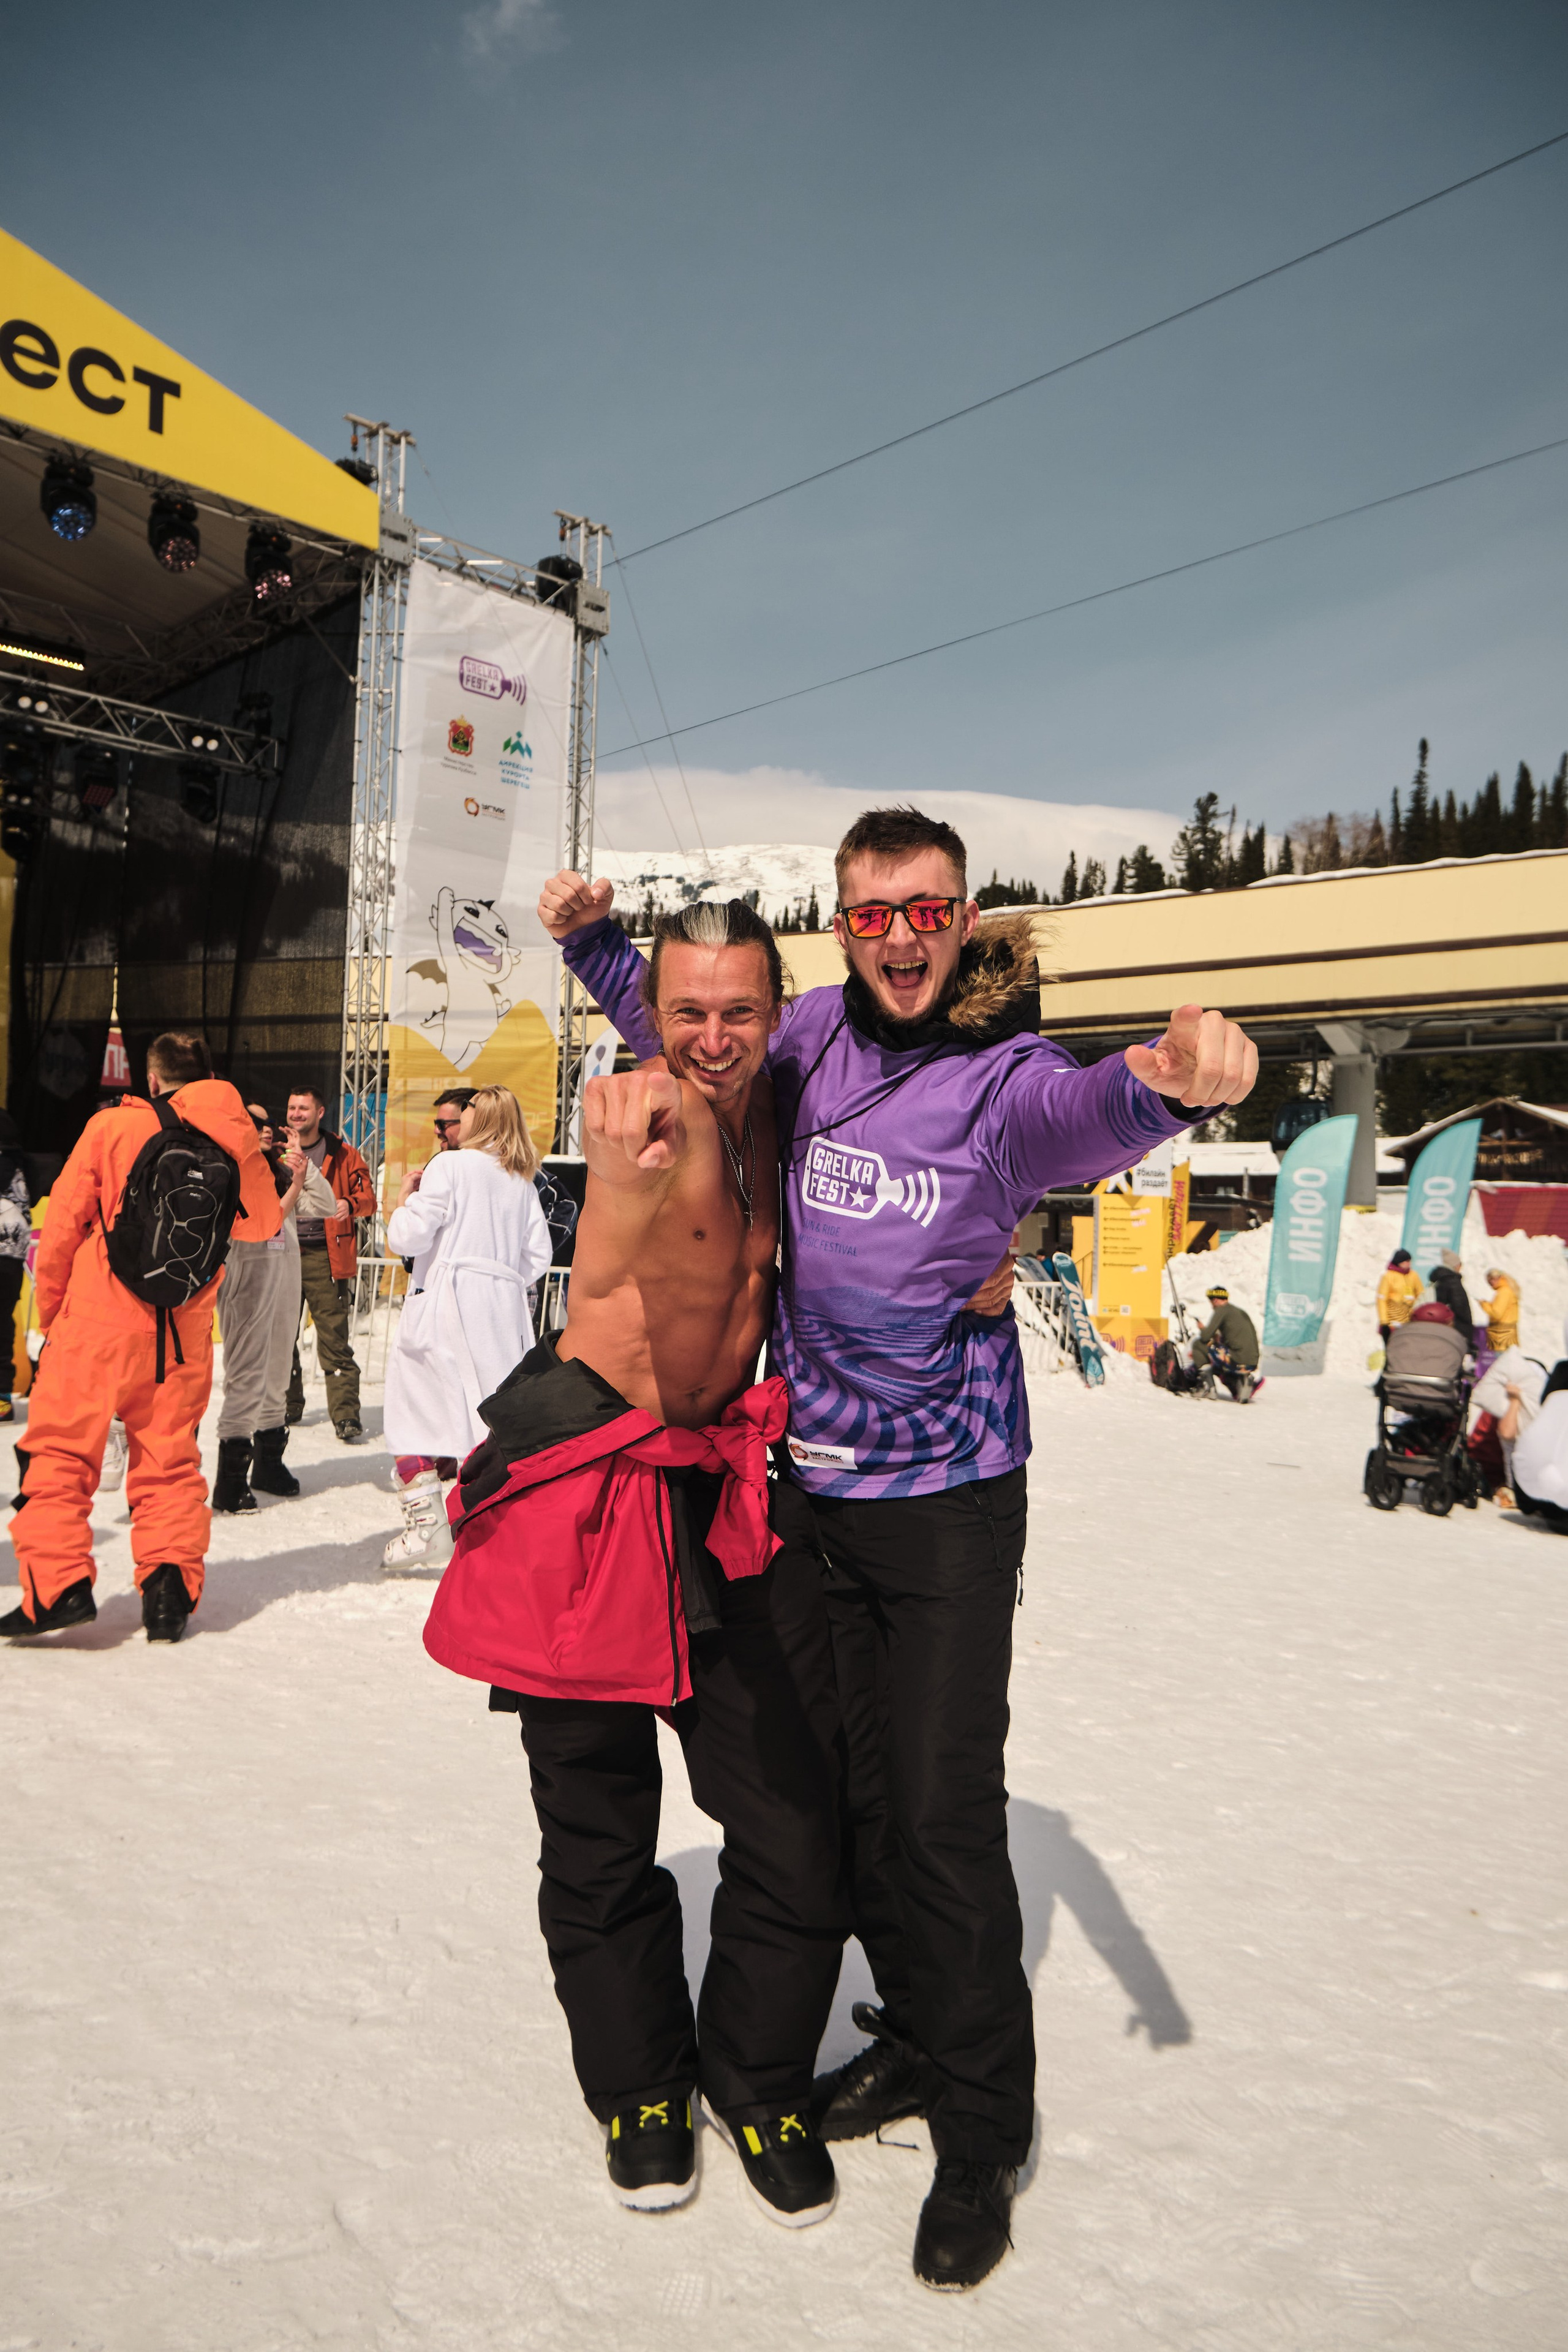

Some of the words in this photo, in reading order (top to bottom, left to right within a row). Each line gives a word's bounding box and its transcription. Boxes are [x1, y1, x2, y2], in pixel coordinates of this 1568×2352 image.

[466, 662, 499, 681] GRELKA
[466, 674, 488, 690] FEST
[499, 760, 533, 773] ДИРЕКЦИЯ
[501, 768, 530, 780] КУРОРТА
[500, 777, 530, 790] ШЕРЕГЕШ
[481, 803, 505, 814] УГМК
[812, 1147, 874, 1185] GRELKA
[1136, 1168, 1166, 1177] #билайн
[810, 1172, 850, 1205] FEST
[1288, 1167, 1328, 1262] ИНФО
[1415, 1176, 1457, 1266] ИНФО
[803, 1217, 815, 1232] SUN
[815, 1223, 821, 1232] &
[821, 1224, 841, 1237] RIDE
[799, 1233, 819, 1248] MUSIC
[820, 1239, 858, 1257] FESTIVAL
[1061, 1272, 1098, 1352] Joint
[809, 1451, 843, 1461] УГМК
